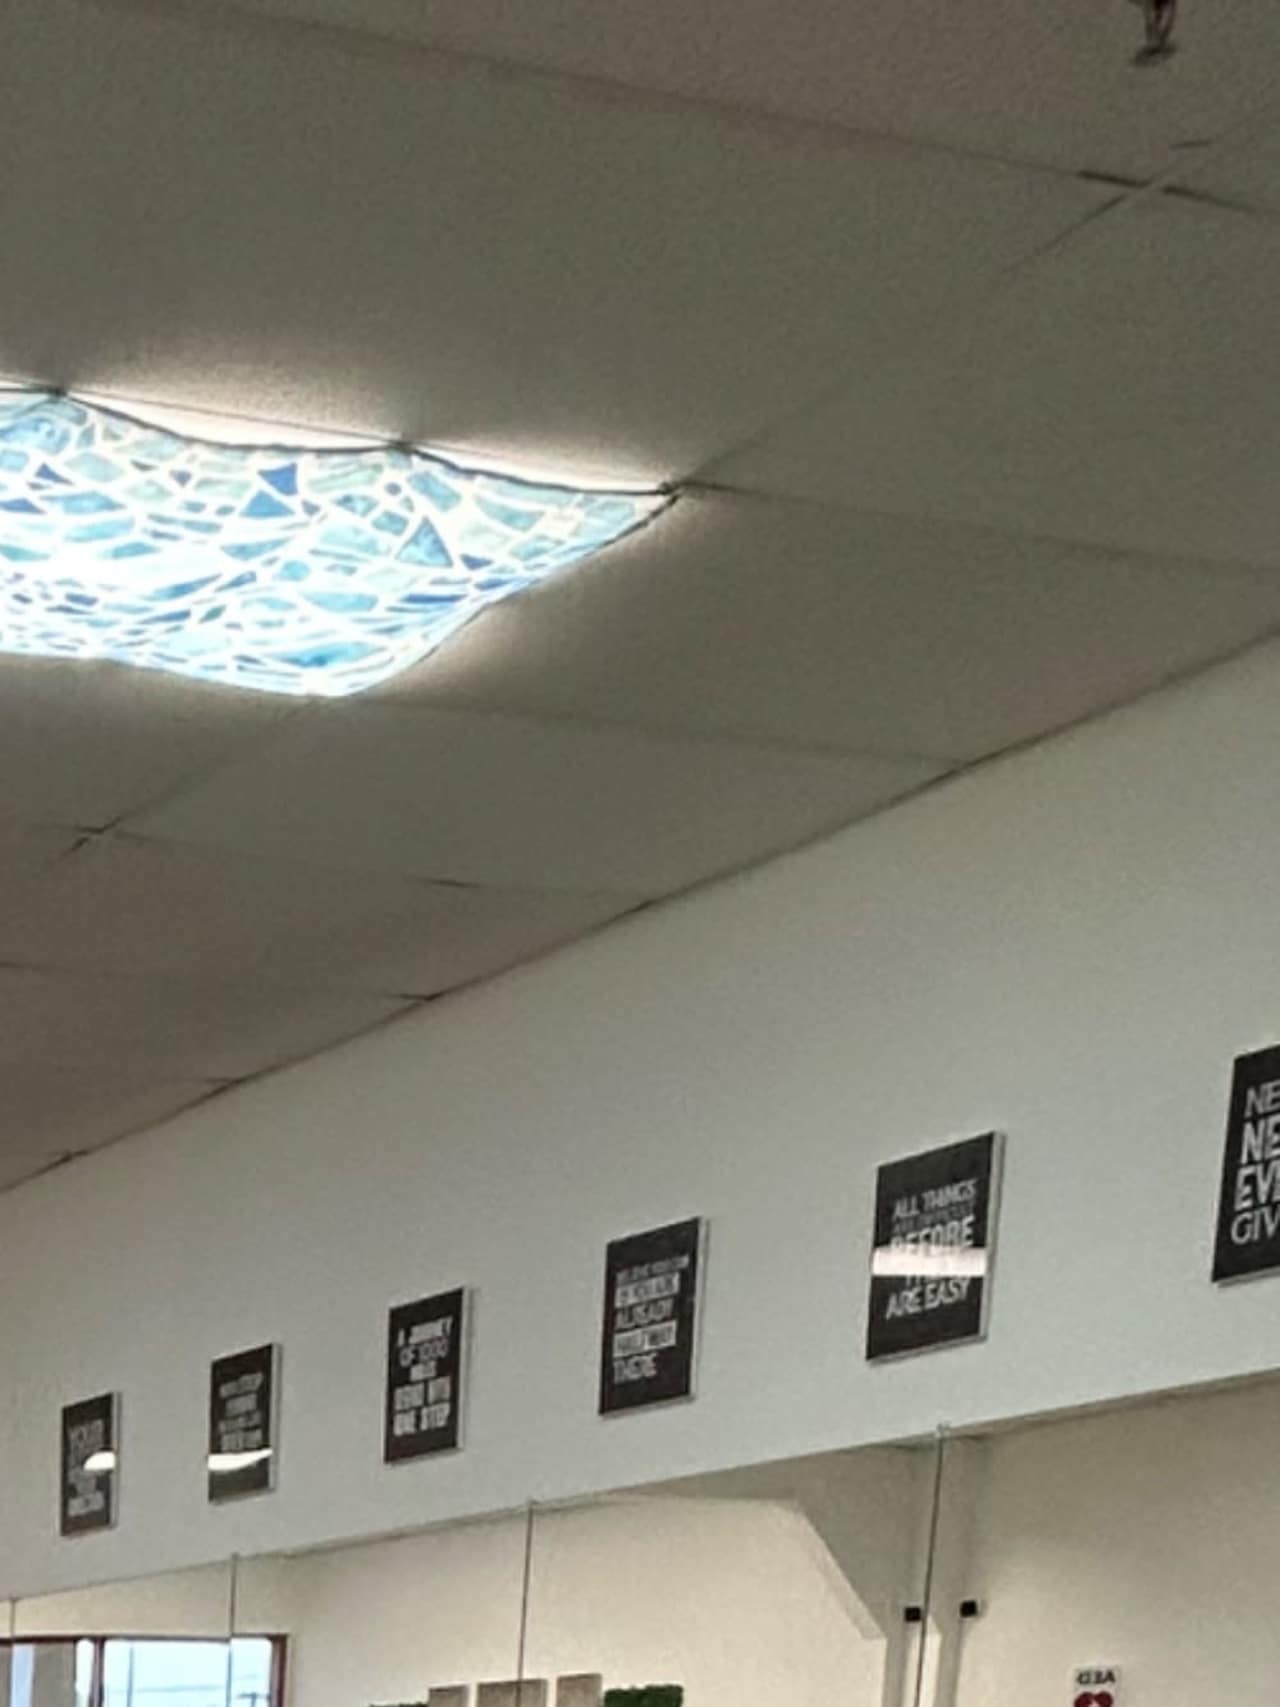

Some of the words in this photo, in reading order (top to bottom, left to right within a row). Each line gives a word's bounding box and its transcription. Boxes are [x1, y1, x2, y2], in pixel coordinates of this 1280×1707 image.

[895, 1195, 919, 1218] ALL
[922, 1179, 978, 1209] THINGS
[886, 1286, 922, 1320] ARE
[925, 1274, 970, 1309] EASY
